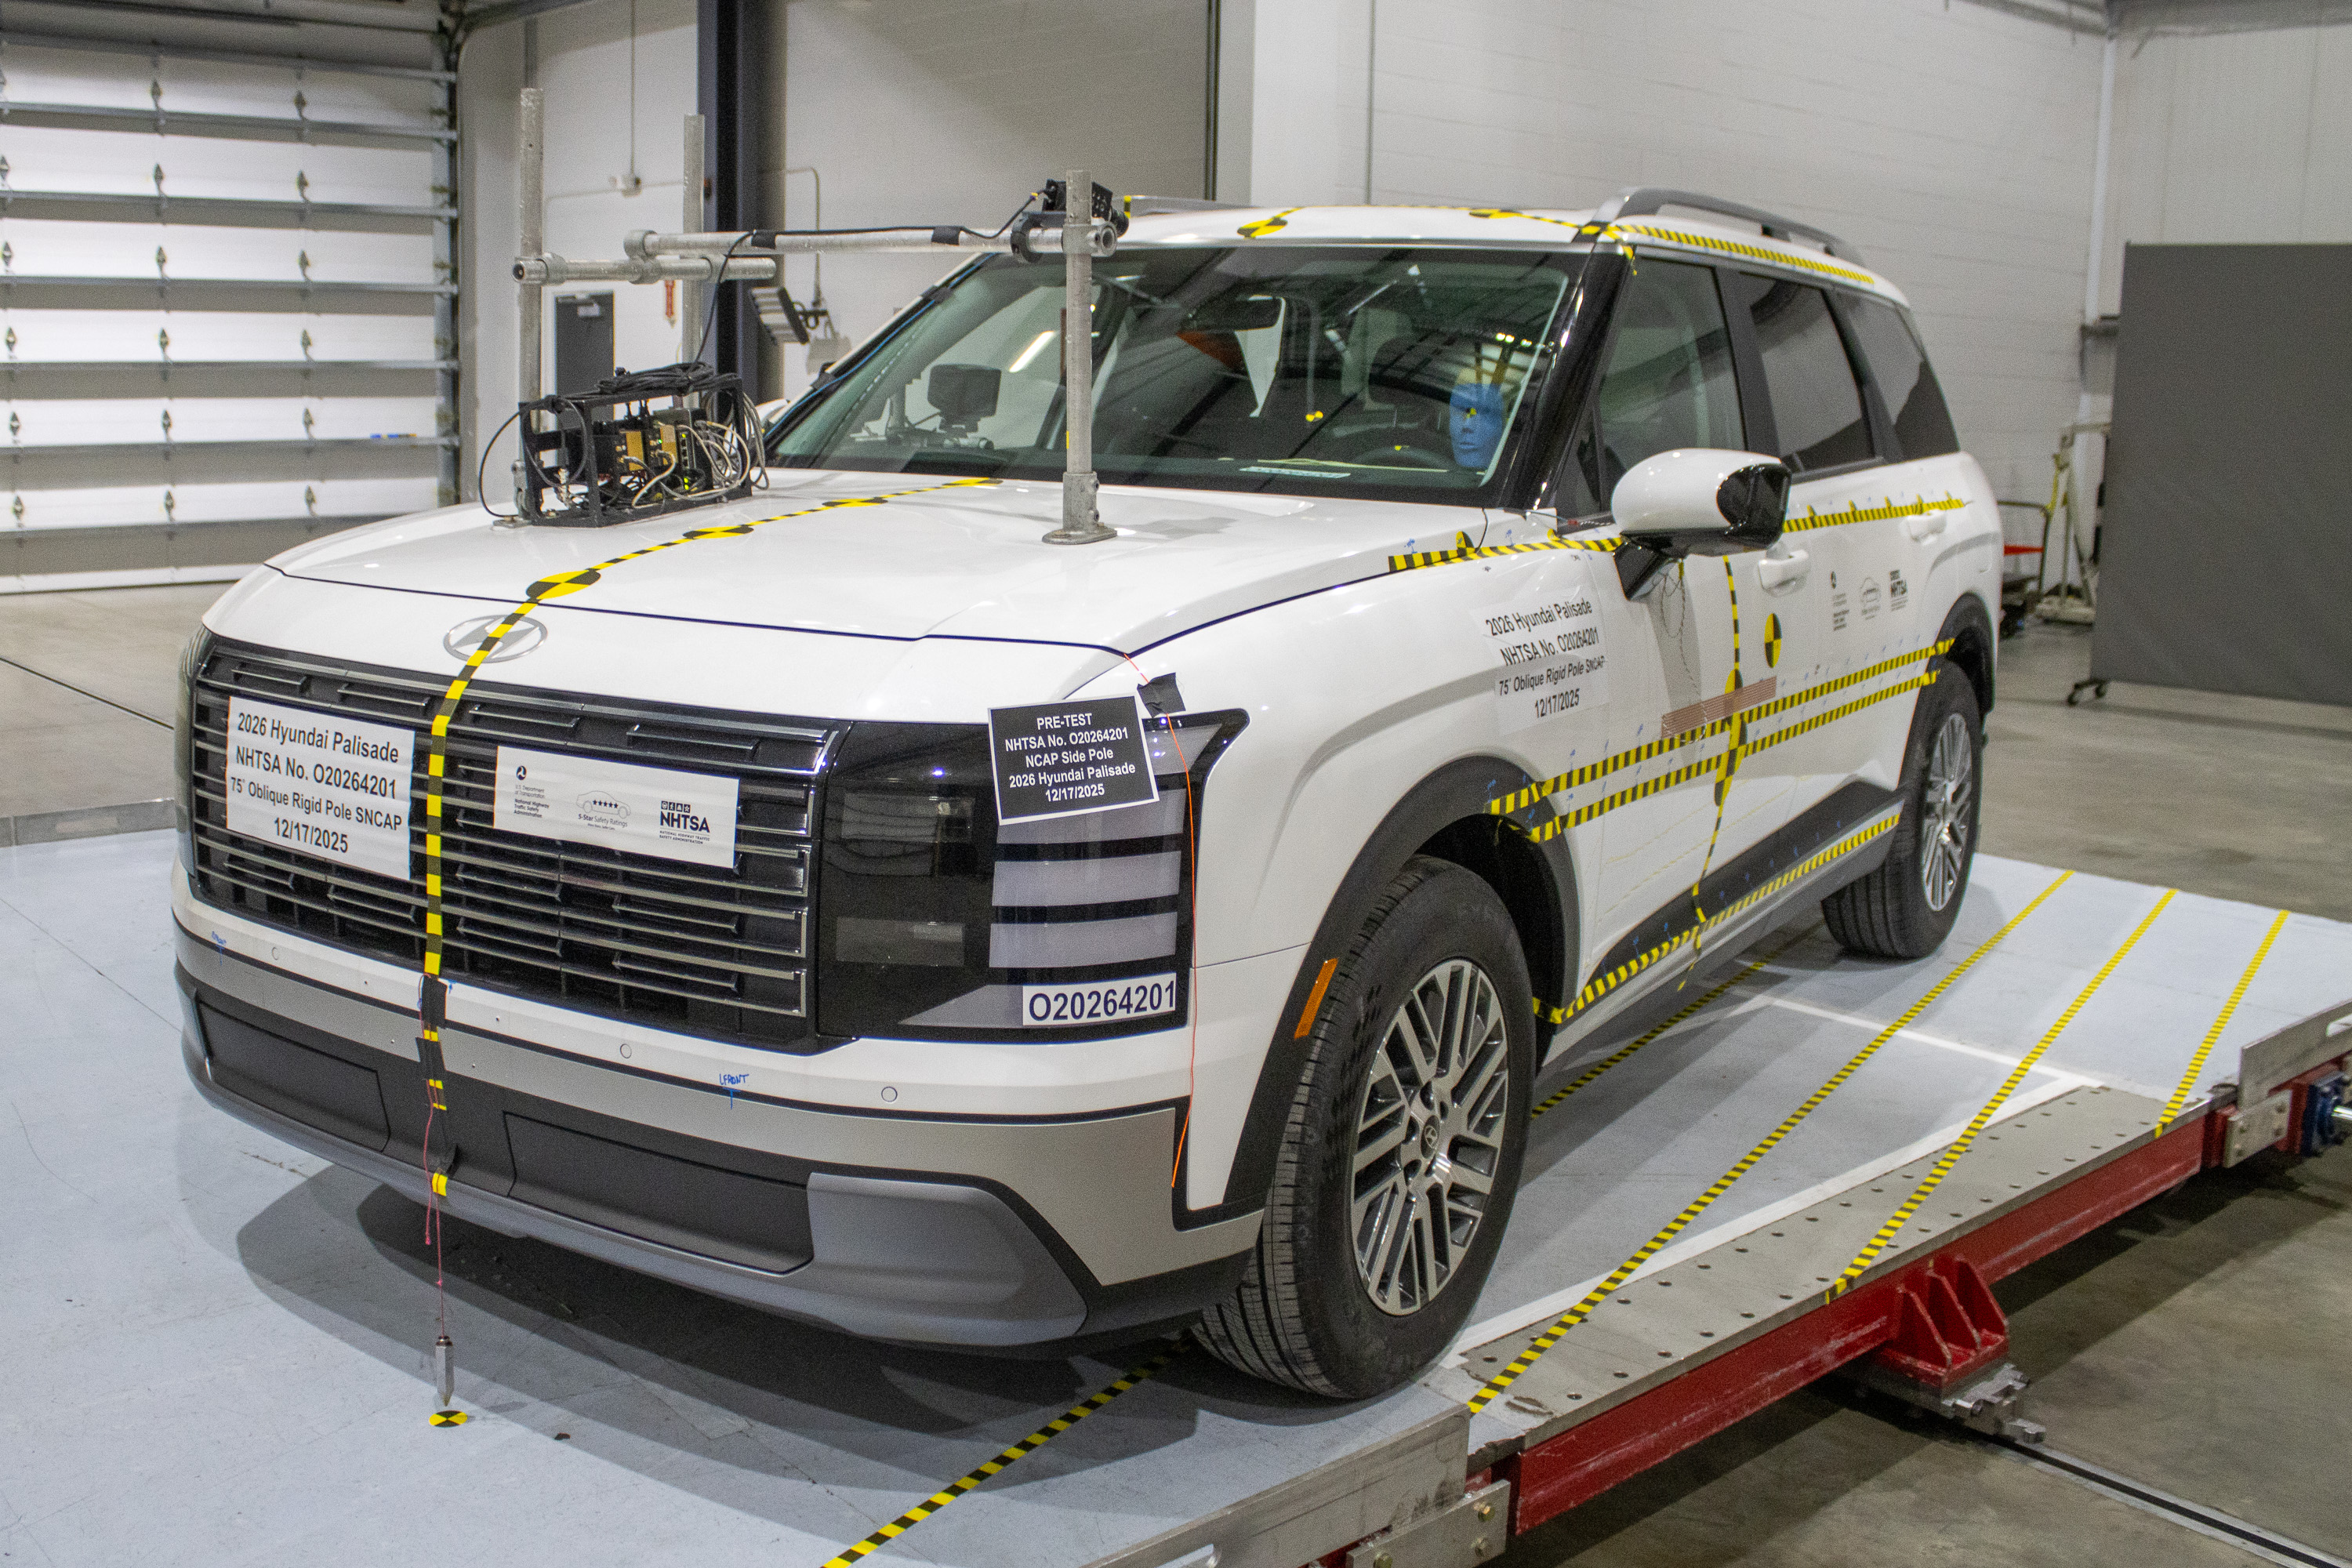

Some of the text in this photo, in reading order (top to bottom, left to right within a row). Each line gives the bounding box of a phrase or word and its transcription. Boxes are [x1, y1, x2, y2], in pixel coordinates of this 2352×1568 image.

[1486, 597, 1593, 636] 2026 Hyundai Palisade
[1500, 626, 1599, 666] NHTSA No. O20264201
[1513, 673, 1544, 691] Oblique
[1546, 666, 1566, 685] Rigid
[1567, 660, 1584, 678] Pole
[1585, 655, 1606, 673] SNCAP
[1534, 688, 1581, 719] 12/17/2025
[238, 712, 399, 763] 2026 Hyundai Palisade
[1036, 713, 1092, 730] PRE-TEST
[1005, 727, 1129, 752] NHTSA No. O20264201
[236, 745, 397, 799] NHTSA No. O20264201
[1025, 747, 1114, 768] NCAP Side Pole
[1009, 762, 1136, 788] 2026 Hyundai Palisade
[248, 781, 289, 807] Oblique
[292, 792, 322, 815] Rigid
[325, 800, 352, 820] Pole
[355, 806, 402, 831] SNCAP
[1045, 783, 1105, 802] 12/17/2025
[274, 817, 348, 853] 12/17/2025
[578, 813, 628, 828] 5-Star Safety Ratings
[659, 811, 710, 833] NHTSA
[1029, 980, 1174, 1022] O20264201
